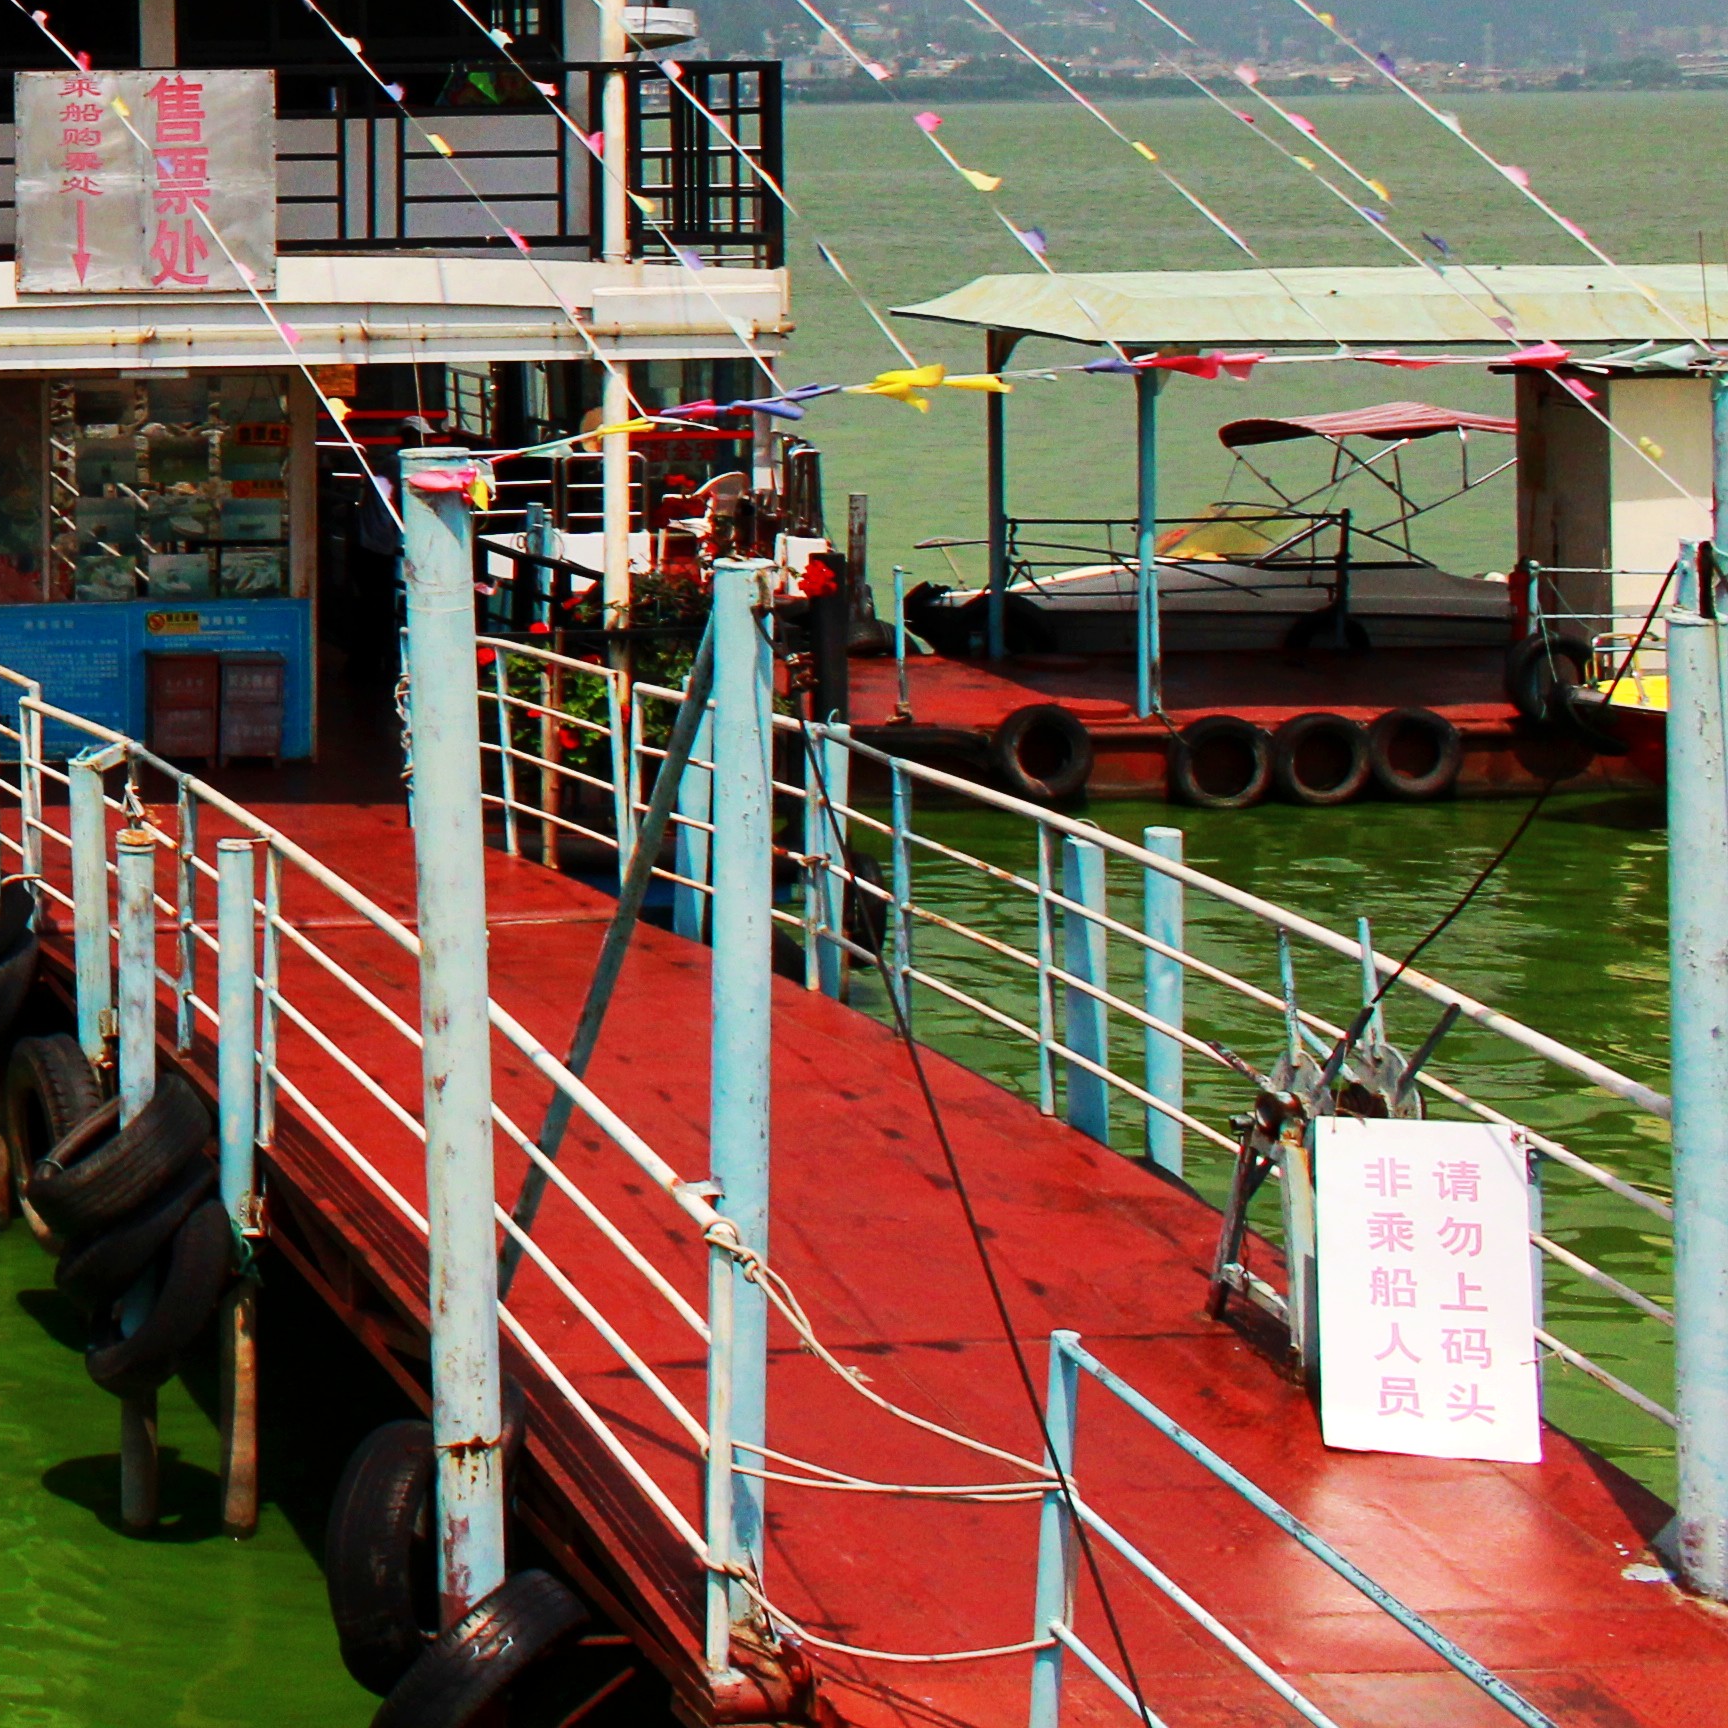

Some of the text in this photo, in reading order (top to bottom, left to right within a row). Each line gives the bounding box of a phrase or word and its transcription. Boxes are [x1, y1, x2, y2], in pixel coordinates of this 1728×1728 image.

[57, 77, 104, 196] 乘船购票处
[143, 75, 211, 286] 售票处
[1364, 1157, 1424, 1418] 非乘船人员
[1432, 1160, 1496, 1424] 请勿上码头
